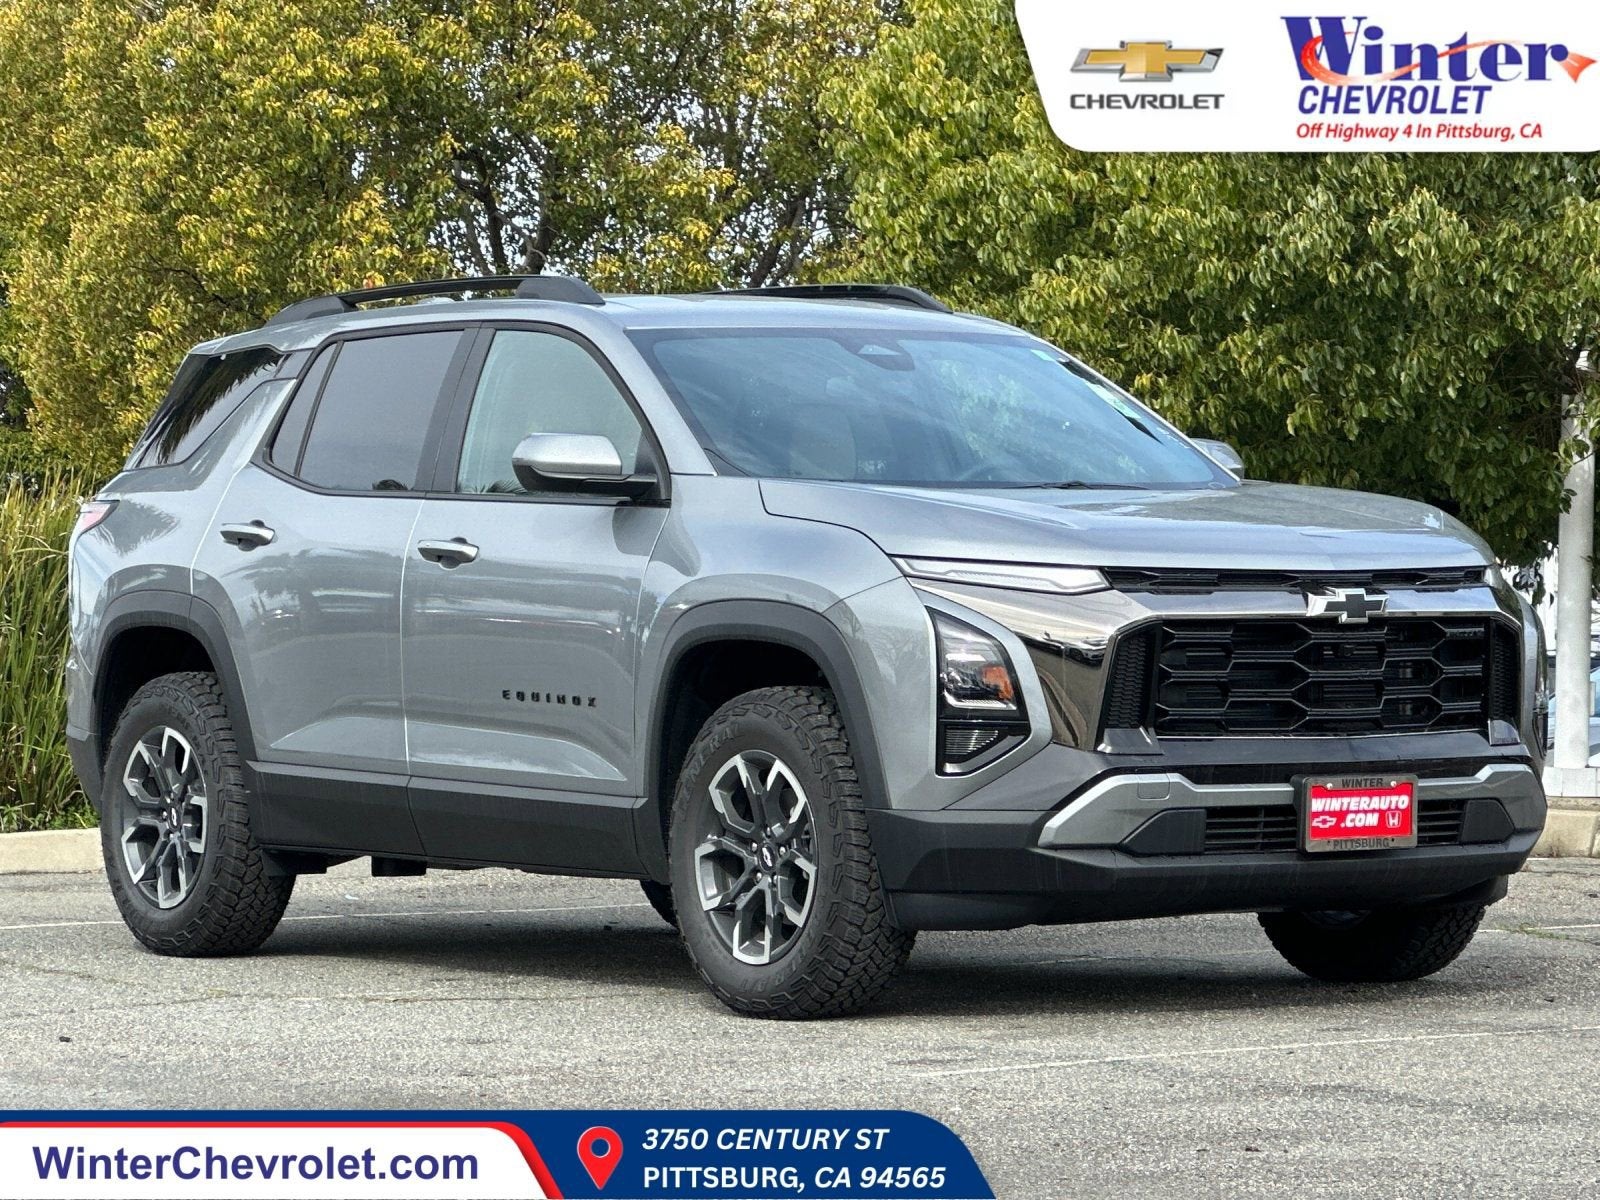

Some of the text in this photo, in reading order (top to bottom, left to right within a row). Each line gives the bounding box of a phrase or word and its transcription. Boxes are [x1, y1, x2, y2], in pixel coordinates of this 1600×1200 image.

[502, 689, 596, 708] EQUINOX
[1341, 778, 1384, 789] WINTER
[1311, 795, 1409, 812] WINTERAUTO
[1340, 812, 1379, 828] .COM
[1333, 838, 1390, 850] PITTSBURG
